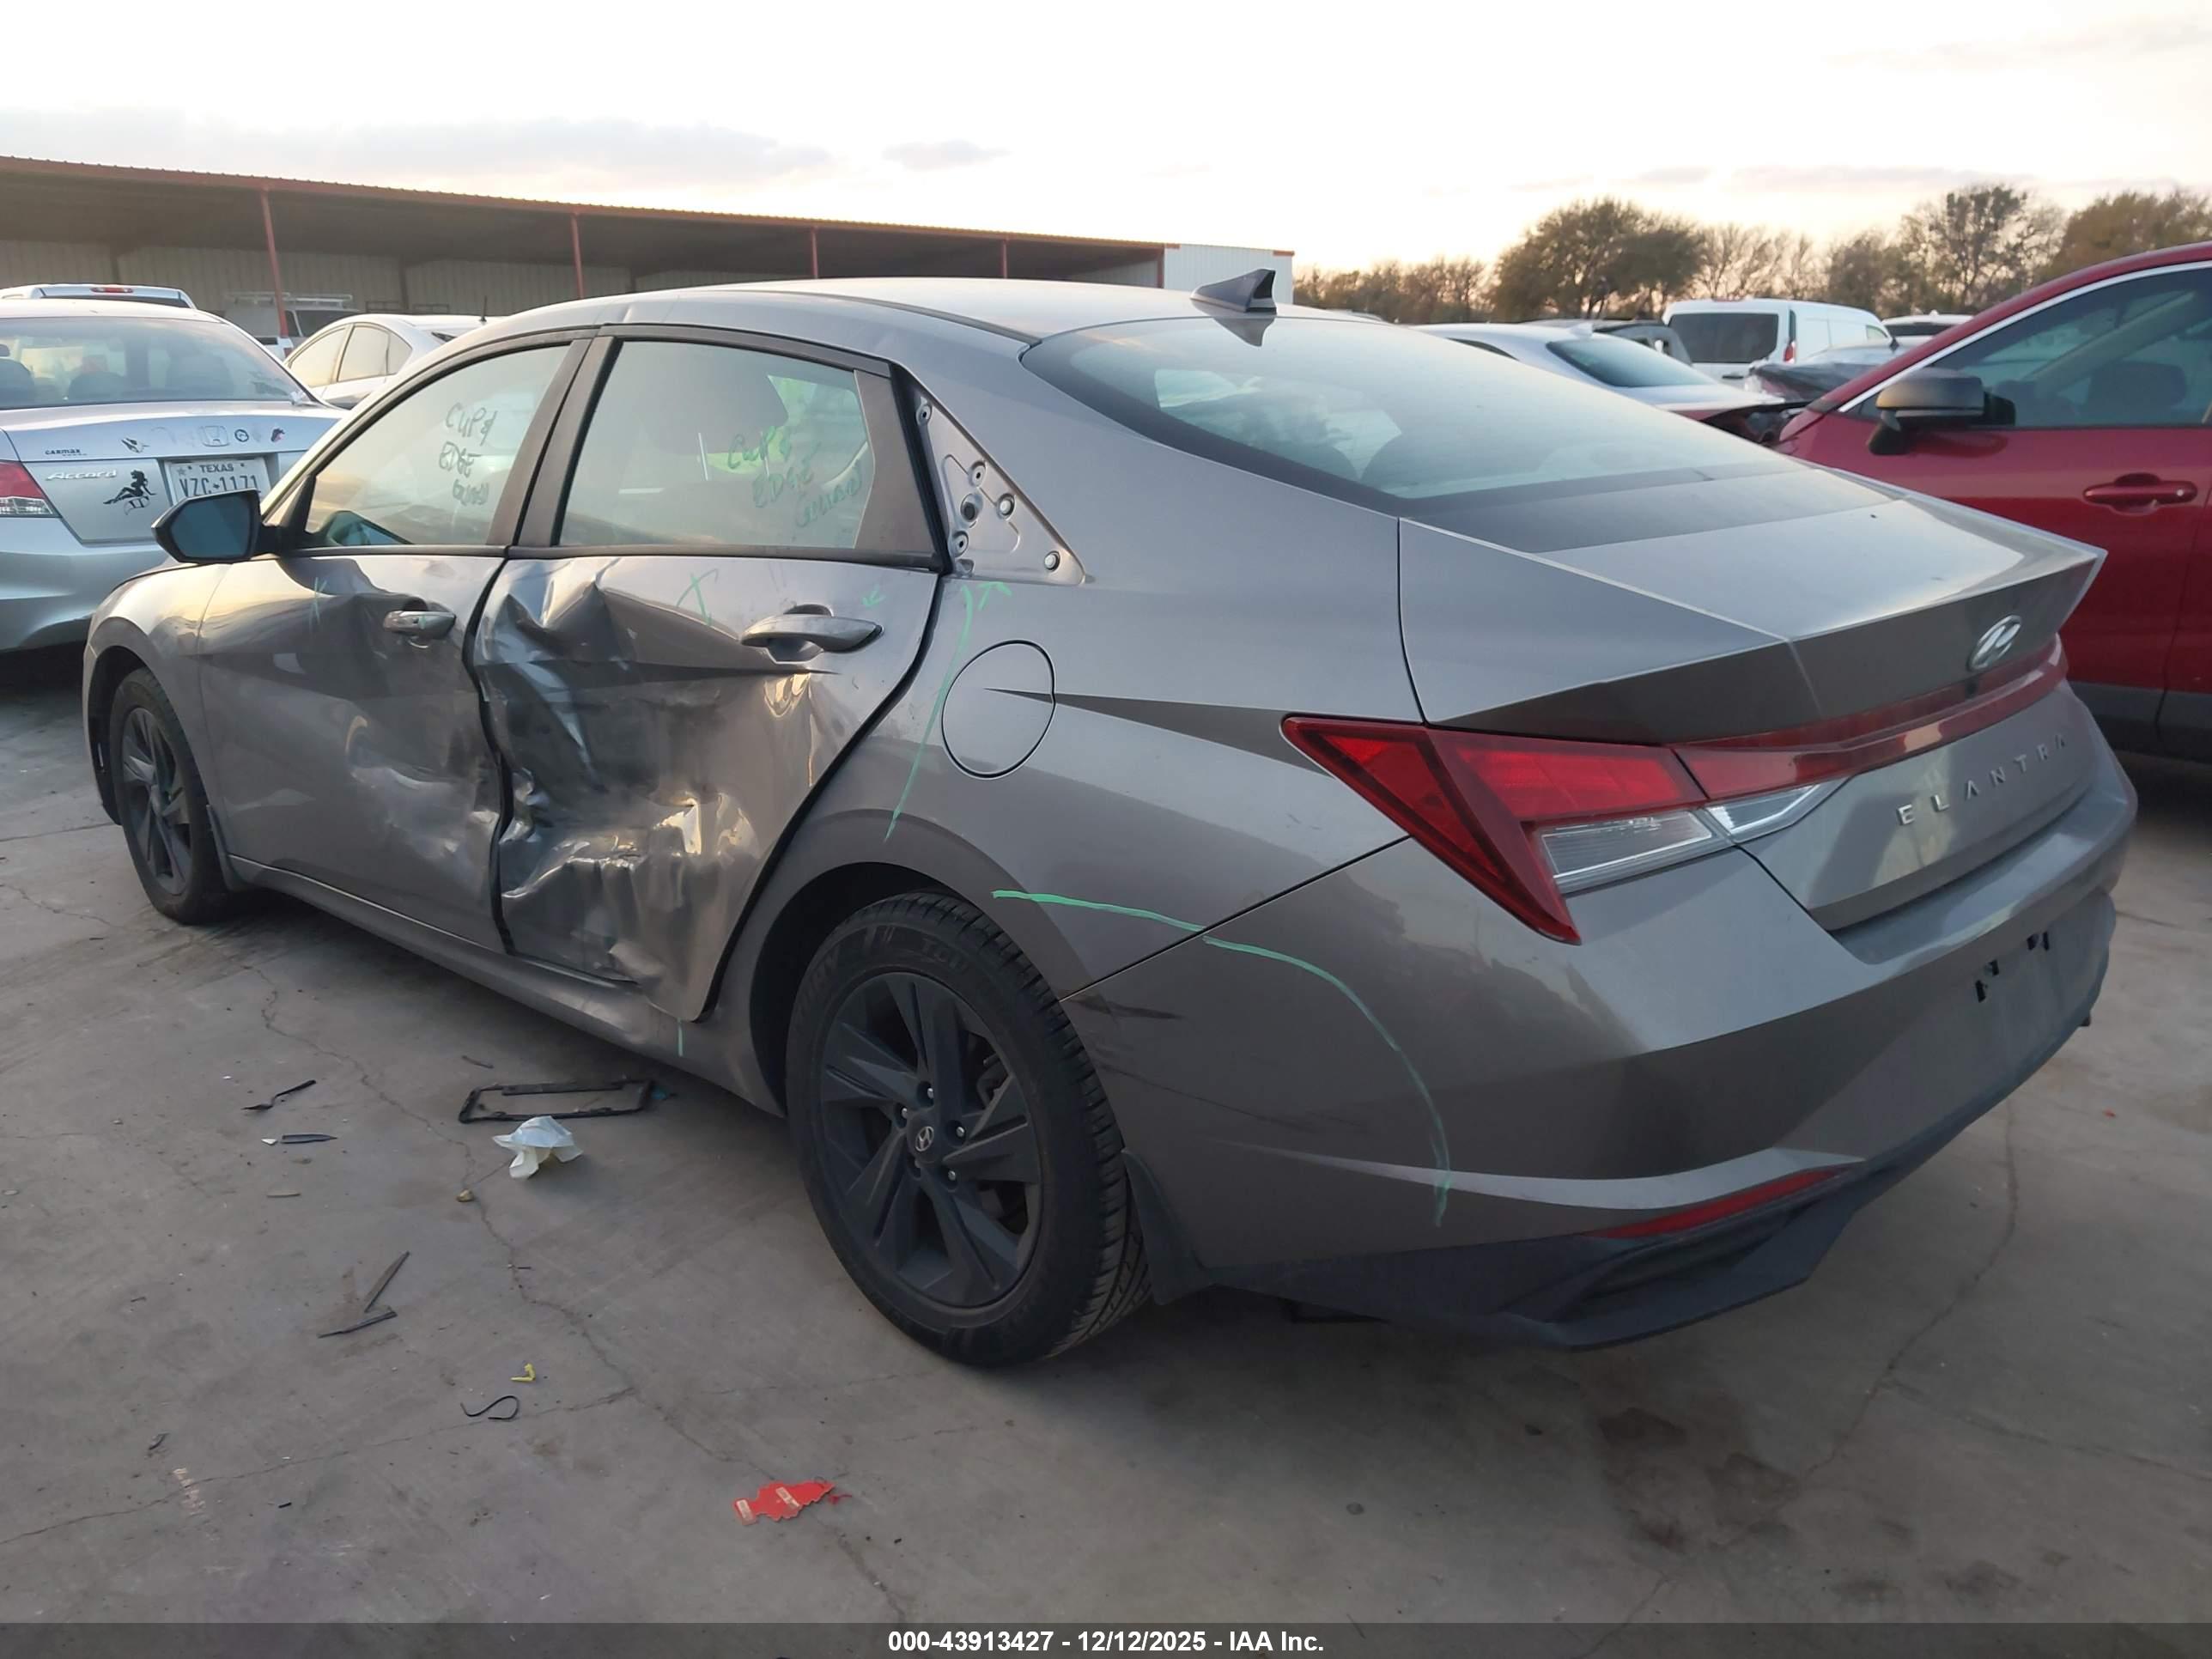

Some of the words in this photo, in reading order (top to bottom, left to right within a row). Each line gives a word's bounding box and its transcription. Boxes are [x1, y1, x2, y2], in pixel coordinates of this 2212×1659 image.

[199, 464, 234, 473] TEXAS
[45, 470, 117, 481] Accord
[1897, 733, 2066, 825] ELANTRA
